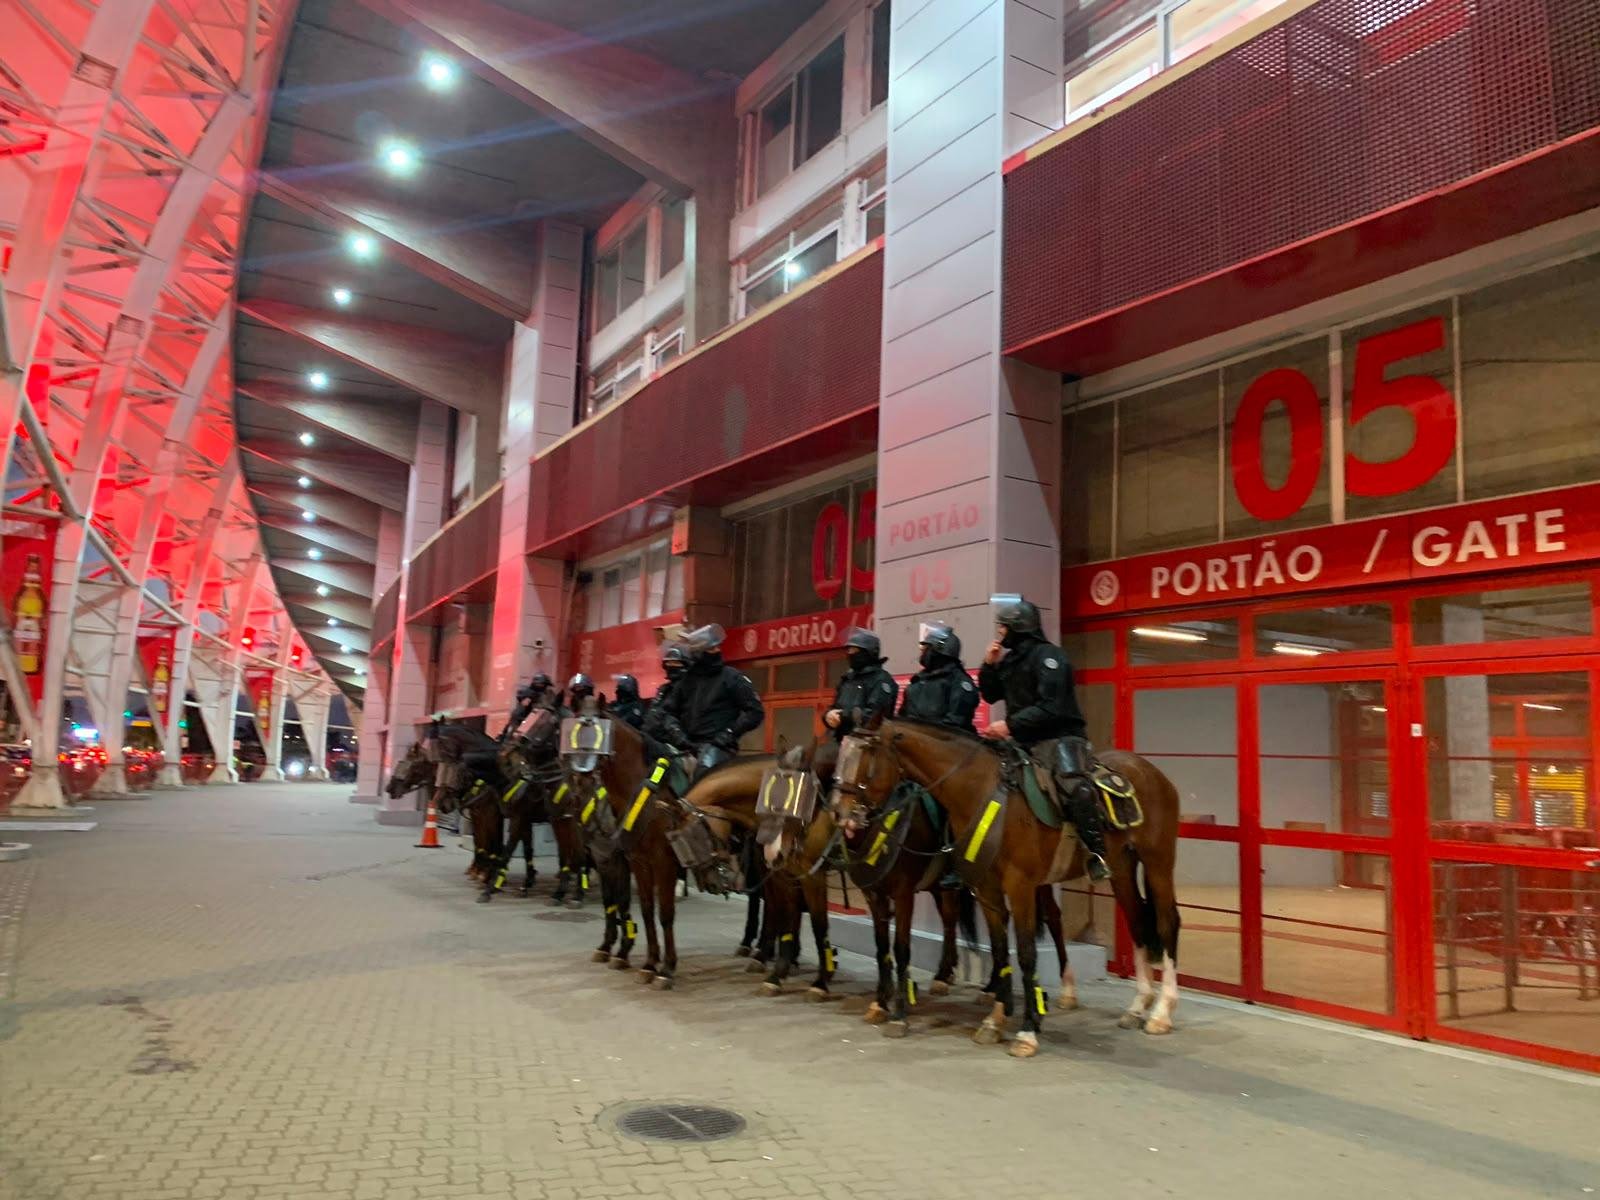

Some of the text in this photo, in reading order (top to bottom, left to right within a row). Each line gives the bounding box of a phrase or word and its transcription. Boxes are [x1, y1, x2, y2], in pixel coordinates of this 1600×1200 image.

[1231, 317, 1457, 521] 05
[889, 504, 979, 546] PORTÃO
[1151, 541, 1322, 598] PORTÃO
[1412, 508, 1566, 568] GATE
[909, 560, 953, 604] 05
[767, 616, 836, 650] PORTÃO
